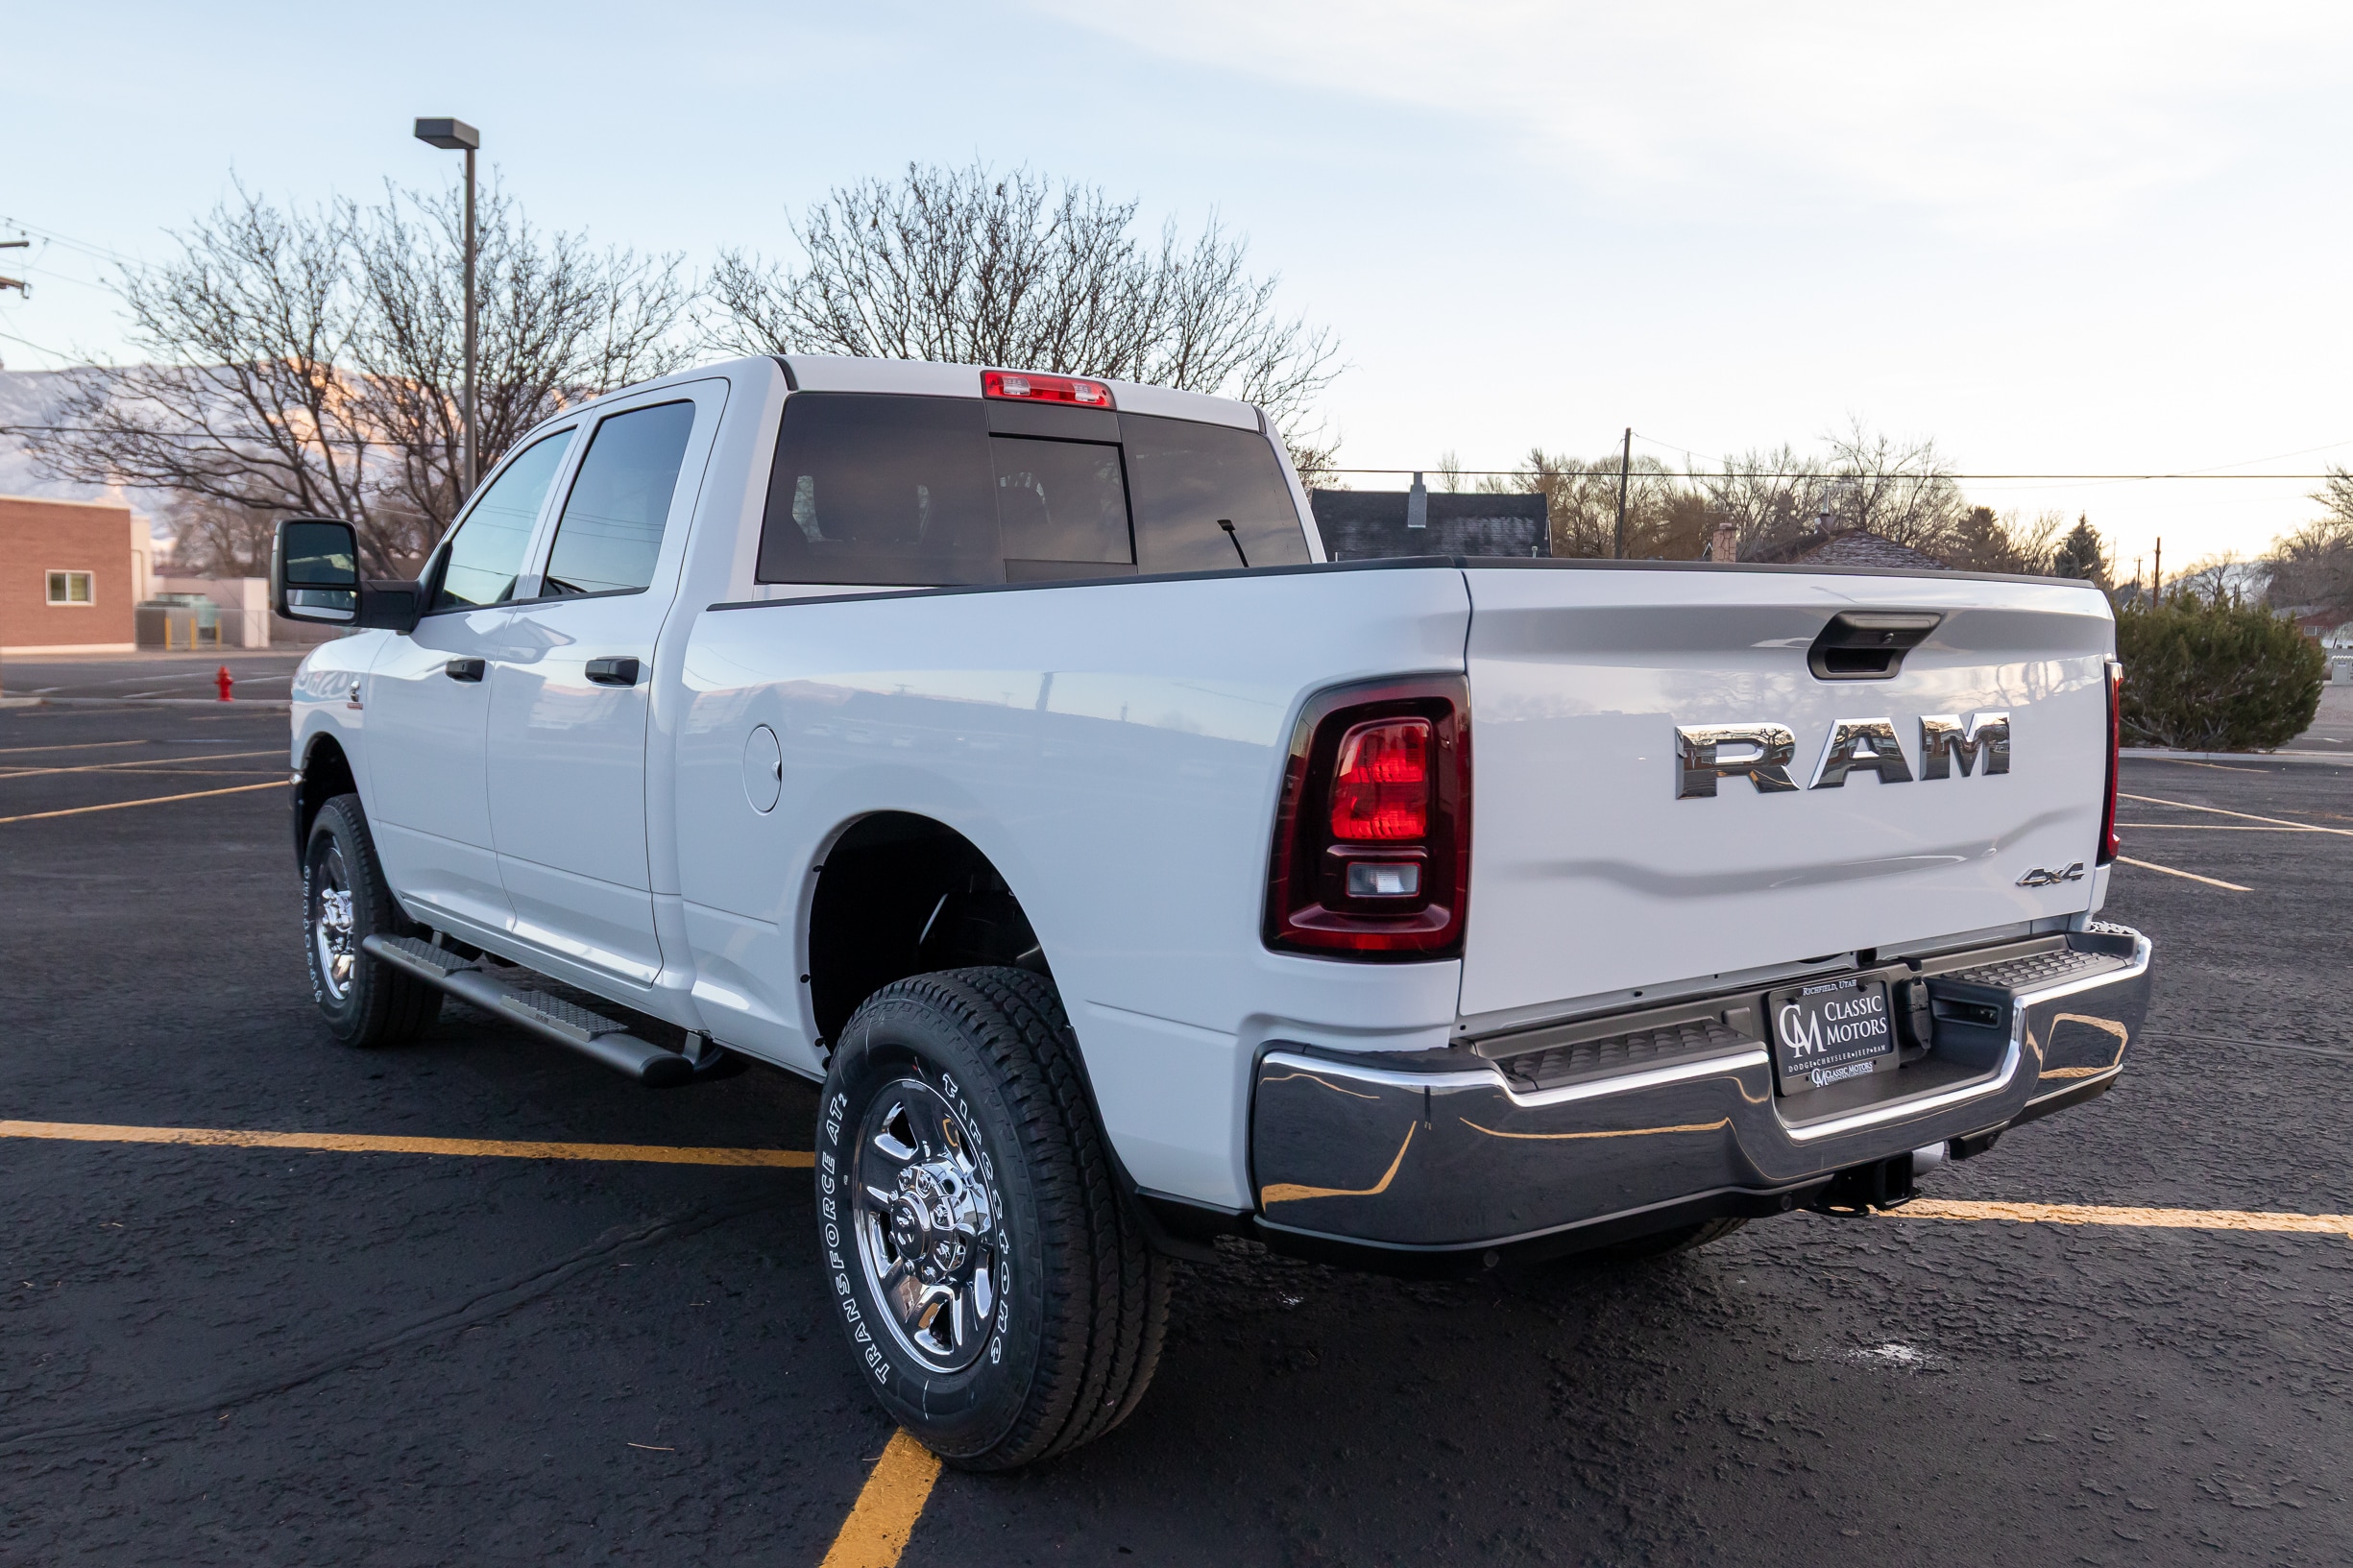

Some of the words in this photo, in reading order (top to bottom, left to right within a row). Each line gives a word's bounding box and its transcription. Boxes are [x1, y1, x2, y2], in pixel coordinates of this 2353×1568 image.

[1675, 712, 2011, 800] RAM
[1839, 979, 1857, 989] UTAH
[1824, 995, 1882, 1022] CLASSIC
[1827, 1017, 1887, 1046] MOTORS
[1788, 1062, 1813, 1073] DODGE
[1817, 1051, 1852, 1066] CHRYSLER
[1855, 1048, 1870, 1058] JEEP
[1873, 1045, 1886, 1053] RAM
[1826, 1068, 1848, 1079] CLASSIC
[1848, 1061, 1873, 1073] MOTORS
[821, 1151, 891, 1384] TRANSFORCE
